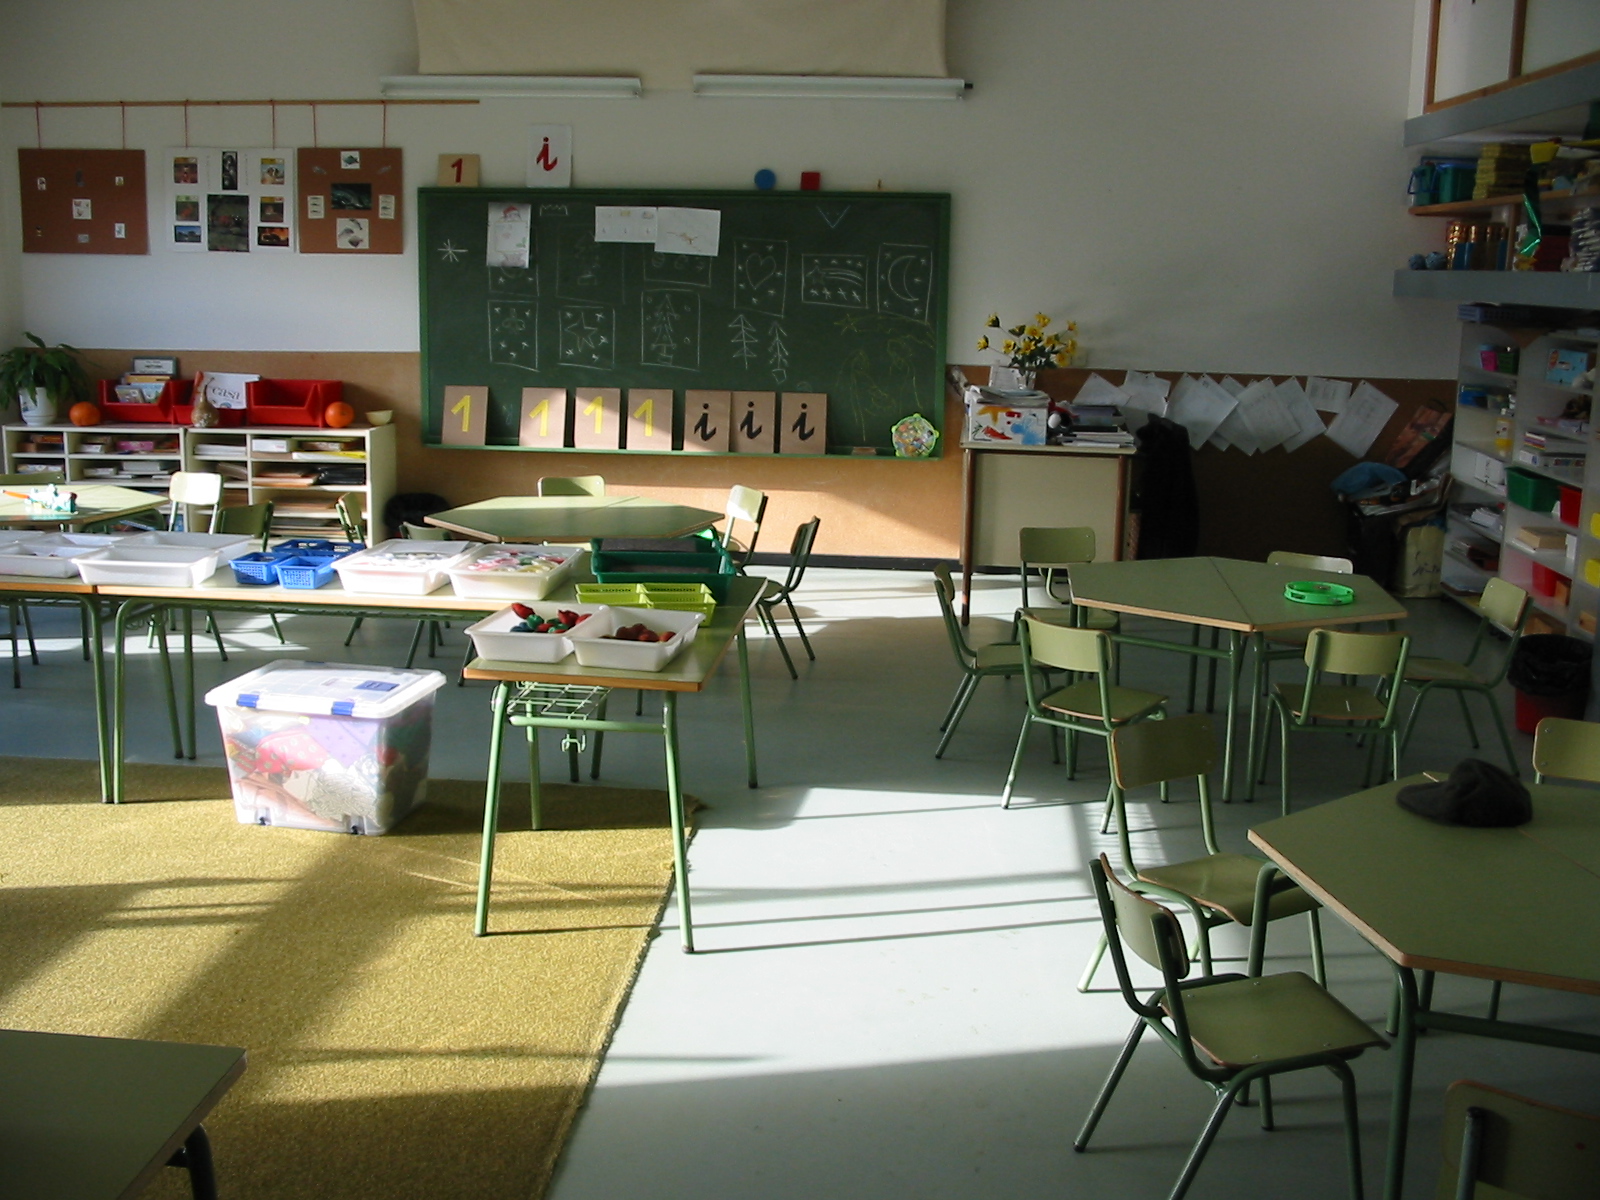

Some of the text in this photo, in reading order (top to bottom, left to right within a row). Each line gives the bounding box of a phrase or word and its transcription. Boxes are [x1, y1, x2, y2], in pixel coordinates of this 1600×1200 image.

[451, 158, 463, 183] 1
[536, 136, 558, 171] i
[451, 394, 471, 432] 1
[529, 399, 549, 437] 1
[583, 395, 603, 434] 1
[633, 399, 653, 437] 1
[693, 403, 717, 441] i
[740, 401, 762, 439] i
[791, 402, 815, 441] i
